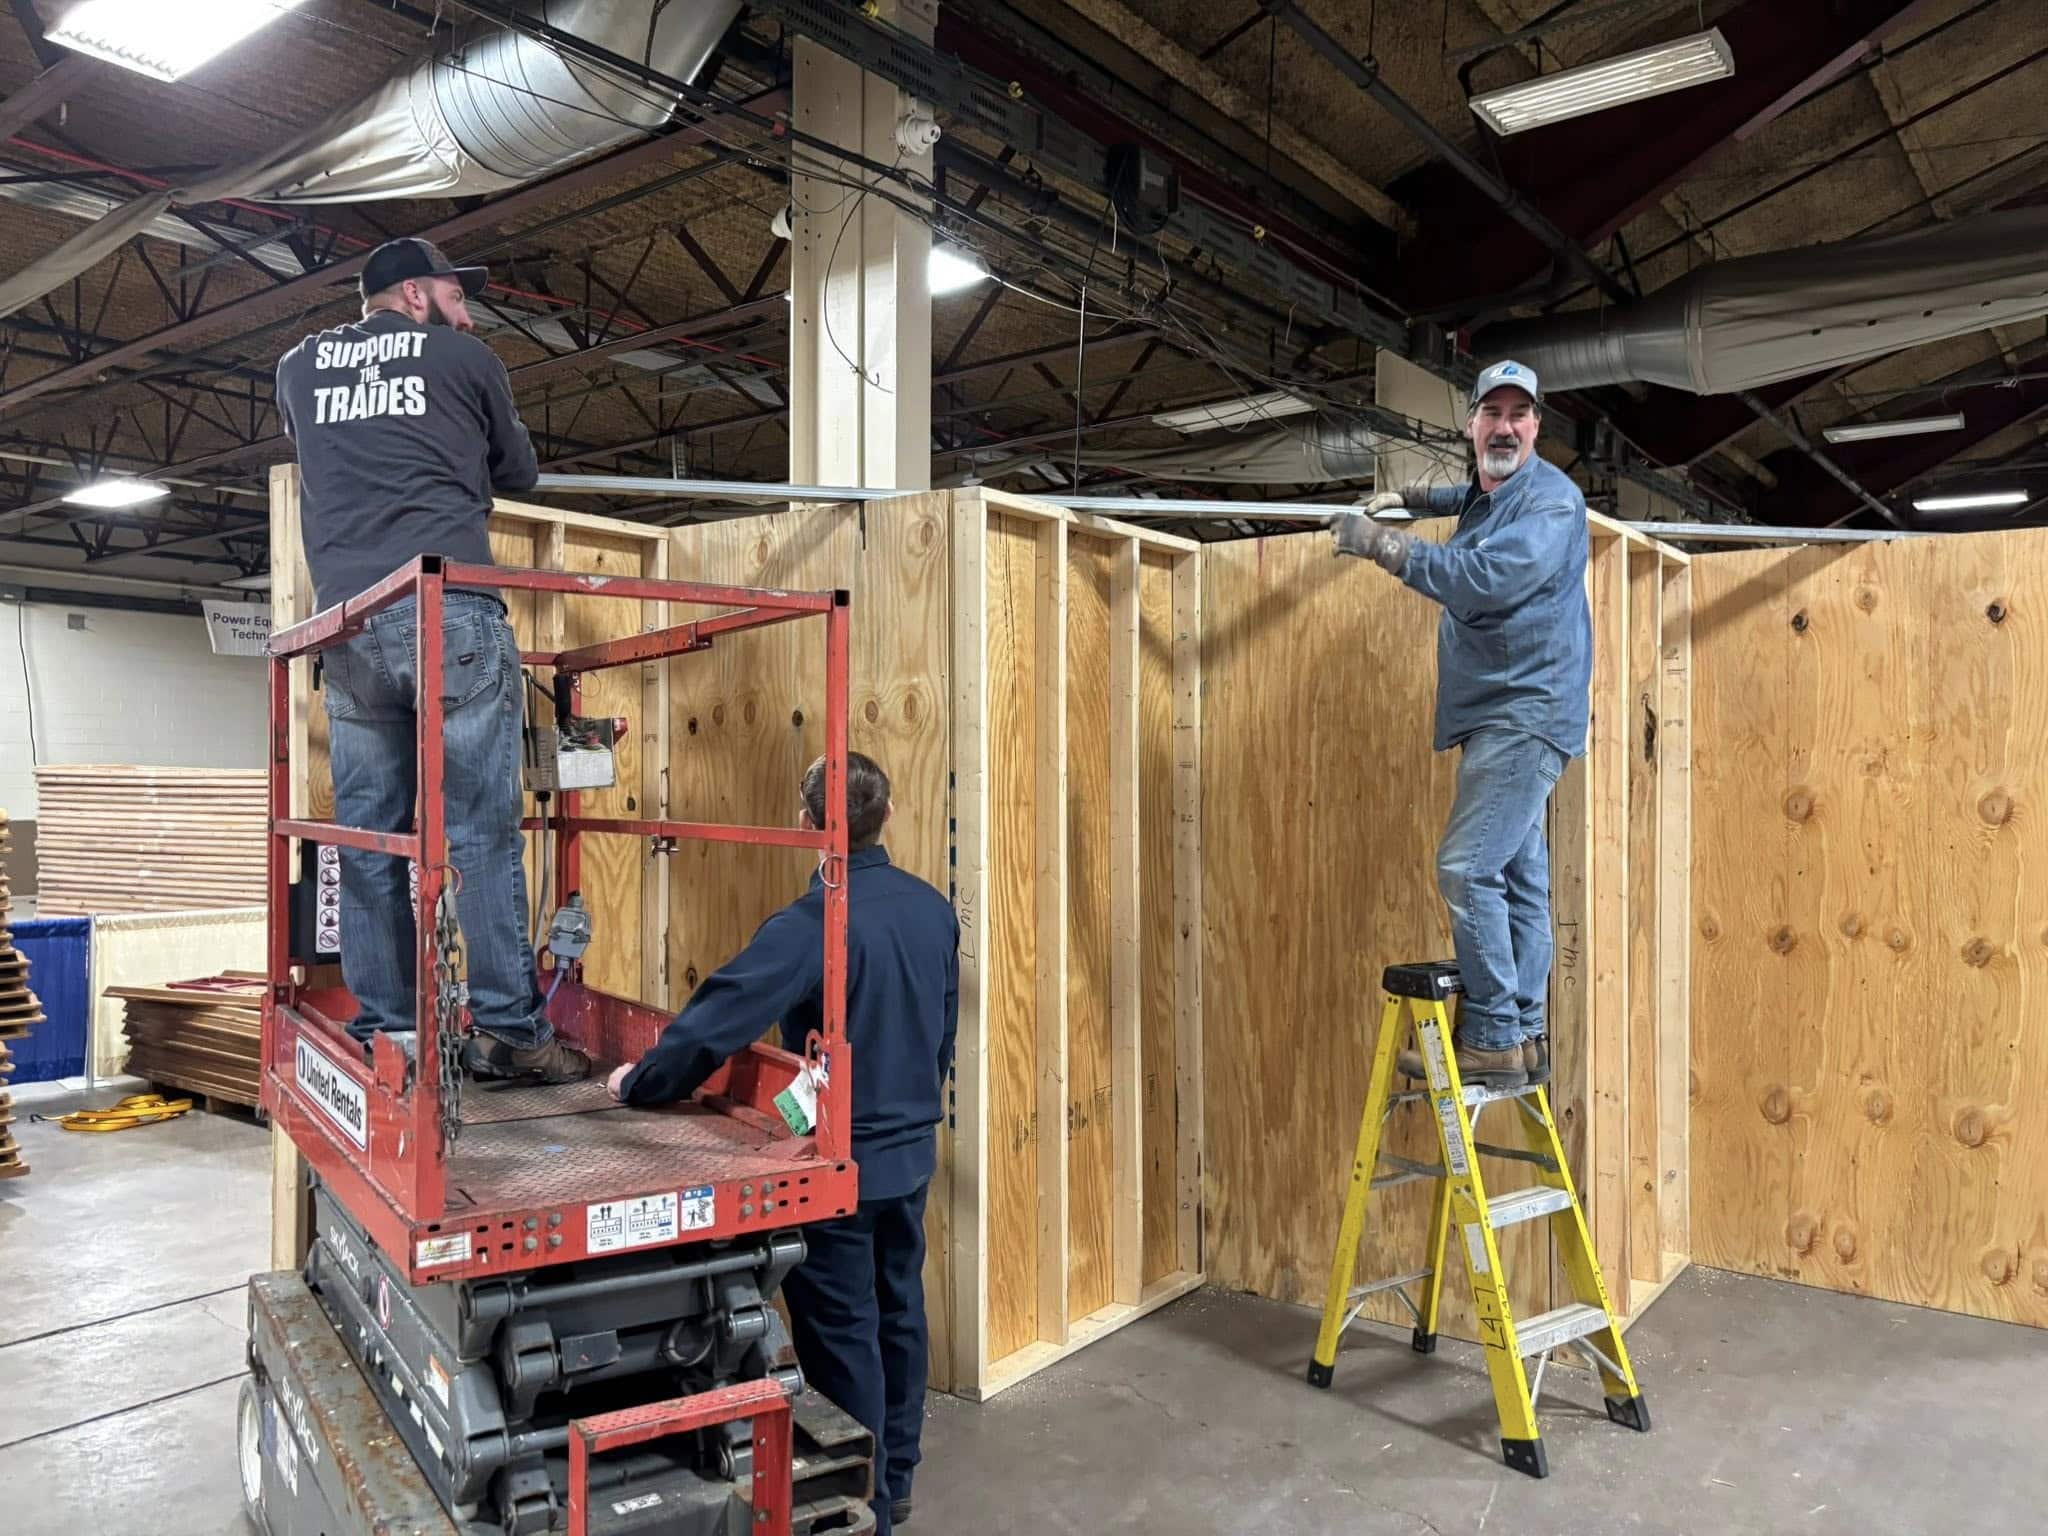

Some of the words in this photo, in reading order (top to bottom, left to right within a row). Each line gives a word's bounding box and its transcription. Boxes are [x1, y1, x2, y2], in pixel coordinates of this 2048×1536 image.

[315, 331, 428, 370] SUPPORT
[360, 364, 380, 383] THE
[314, 375, 426, 424] TRADES
[213, 612, 251, 625] Power
[306, 1053, 330, 1101] United
[331, 1075, 362, 1131] Rentals
